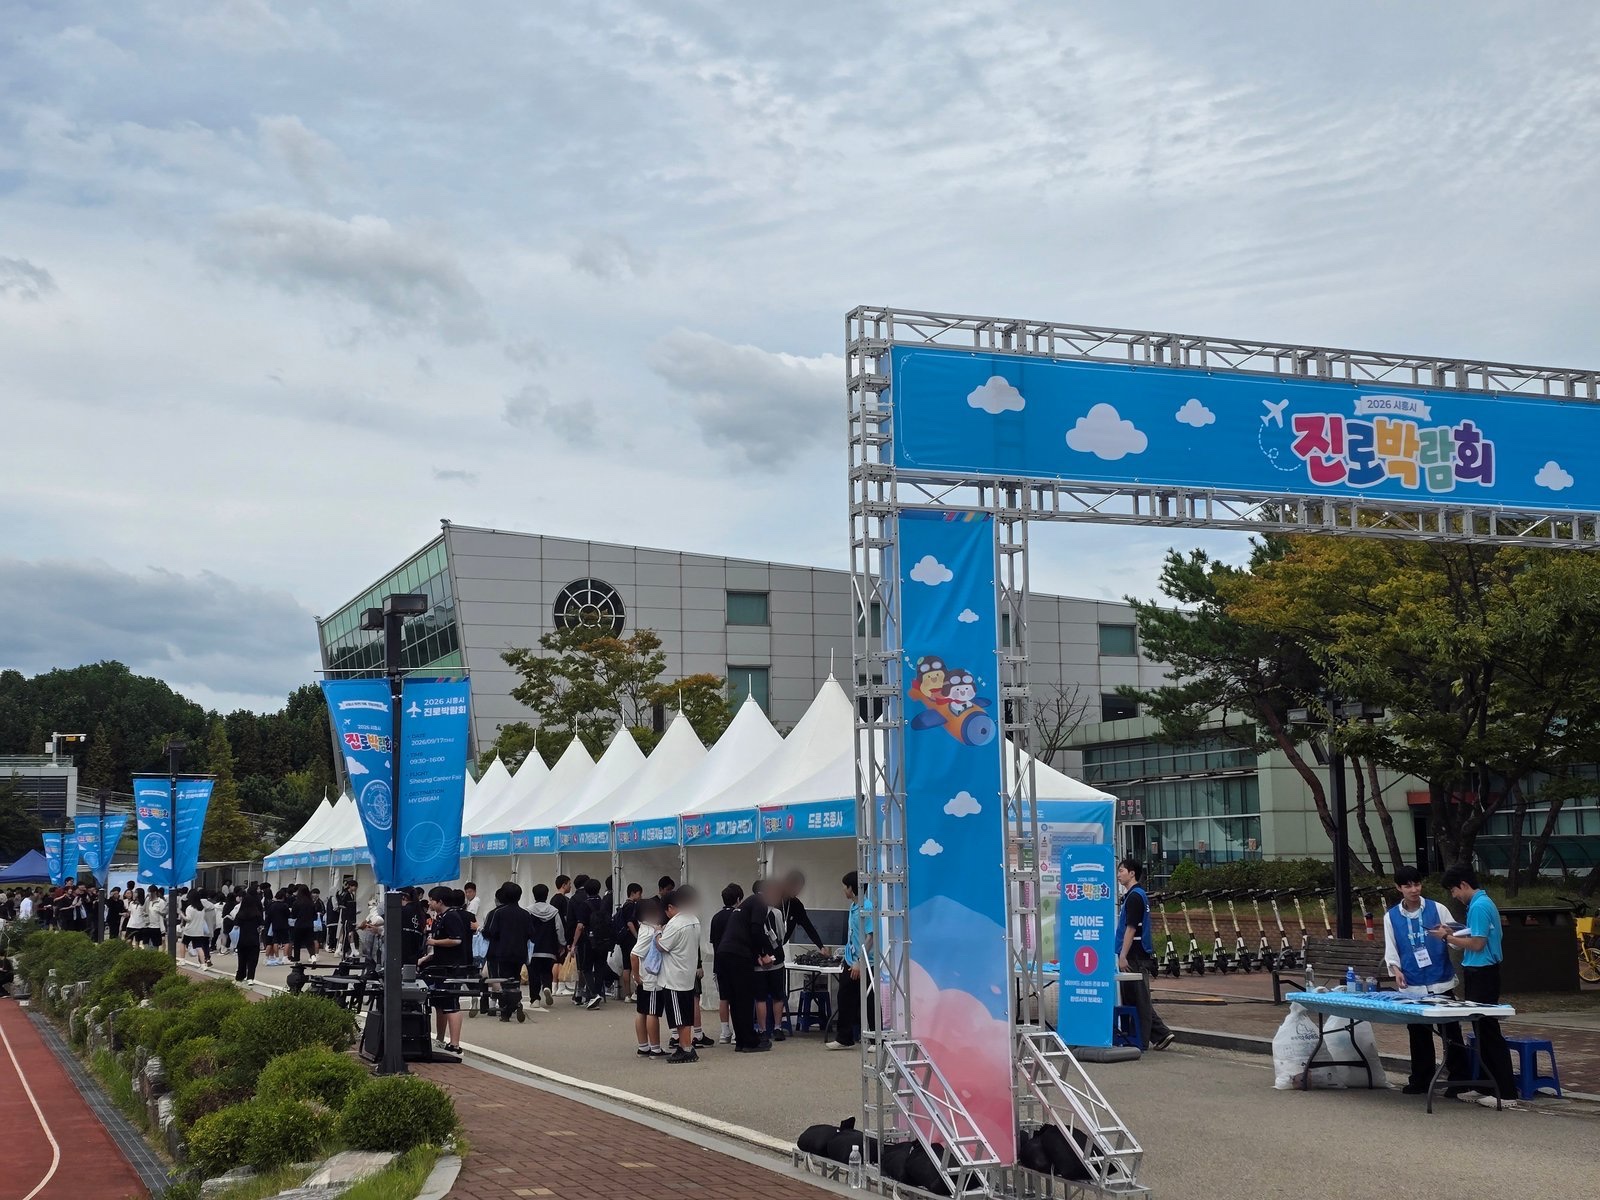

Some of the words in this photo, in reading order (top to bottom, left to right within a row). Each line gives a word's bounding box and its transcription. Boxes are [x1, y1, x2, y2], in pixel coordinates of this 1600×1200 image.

[1367, 399, 1392, 409] 2026
[1393, 400, 1418, 412] 시흥시
[1292, 414, 1494, 492] 진로박람회
[424, 698, 444, 706] 2026
[445, 696, 465, 704] 시흥시
[424, 705, 467, 717] 진로박람회
[344, 732, 392, 753] 진로박람회
[418, 795, 440, 803] DREAM
[808, 812, 821, 829] 드론
[823, 811, 843, 828] 조종사
[1064, 883, 1110, 901] 진로박람회
[1069, 915, 1104, 928] 레이어드
[1074, 929, 1100, 941] 스탬프
[1082, 952, 1089, 968] 1
